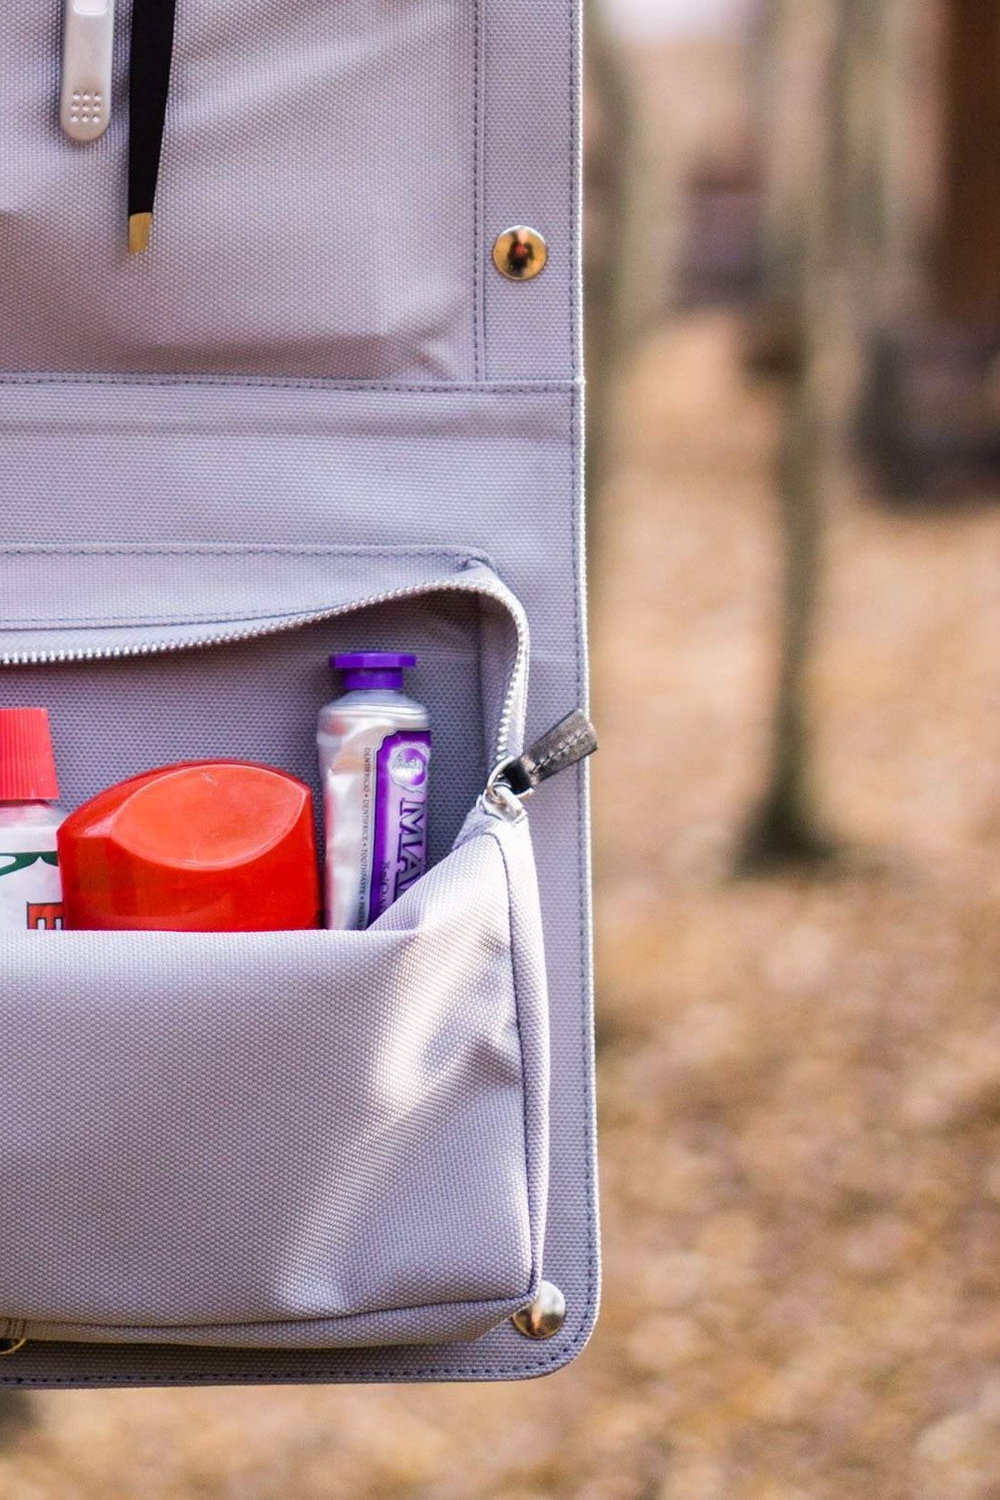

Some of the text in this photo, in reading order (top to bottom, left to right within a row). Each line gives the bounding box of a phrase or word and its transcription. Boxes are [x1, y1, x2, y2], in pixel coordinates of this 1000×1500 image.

[362, 799, 370, 843] DENTIFRICE
[359, 848, 368, 895] TOOTHPASTE
[395, 797, 427, 904] MA
